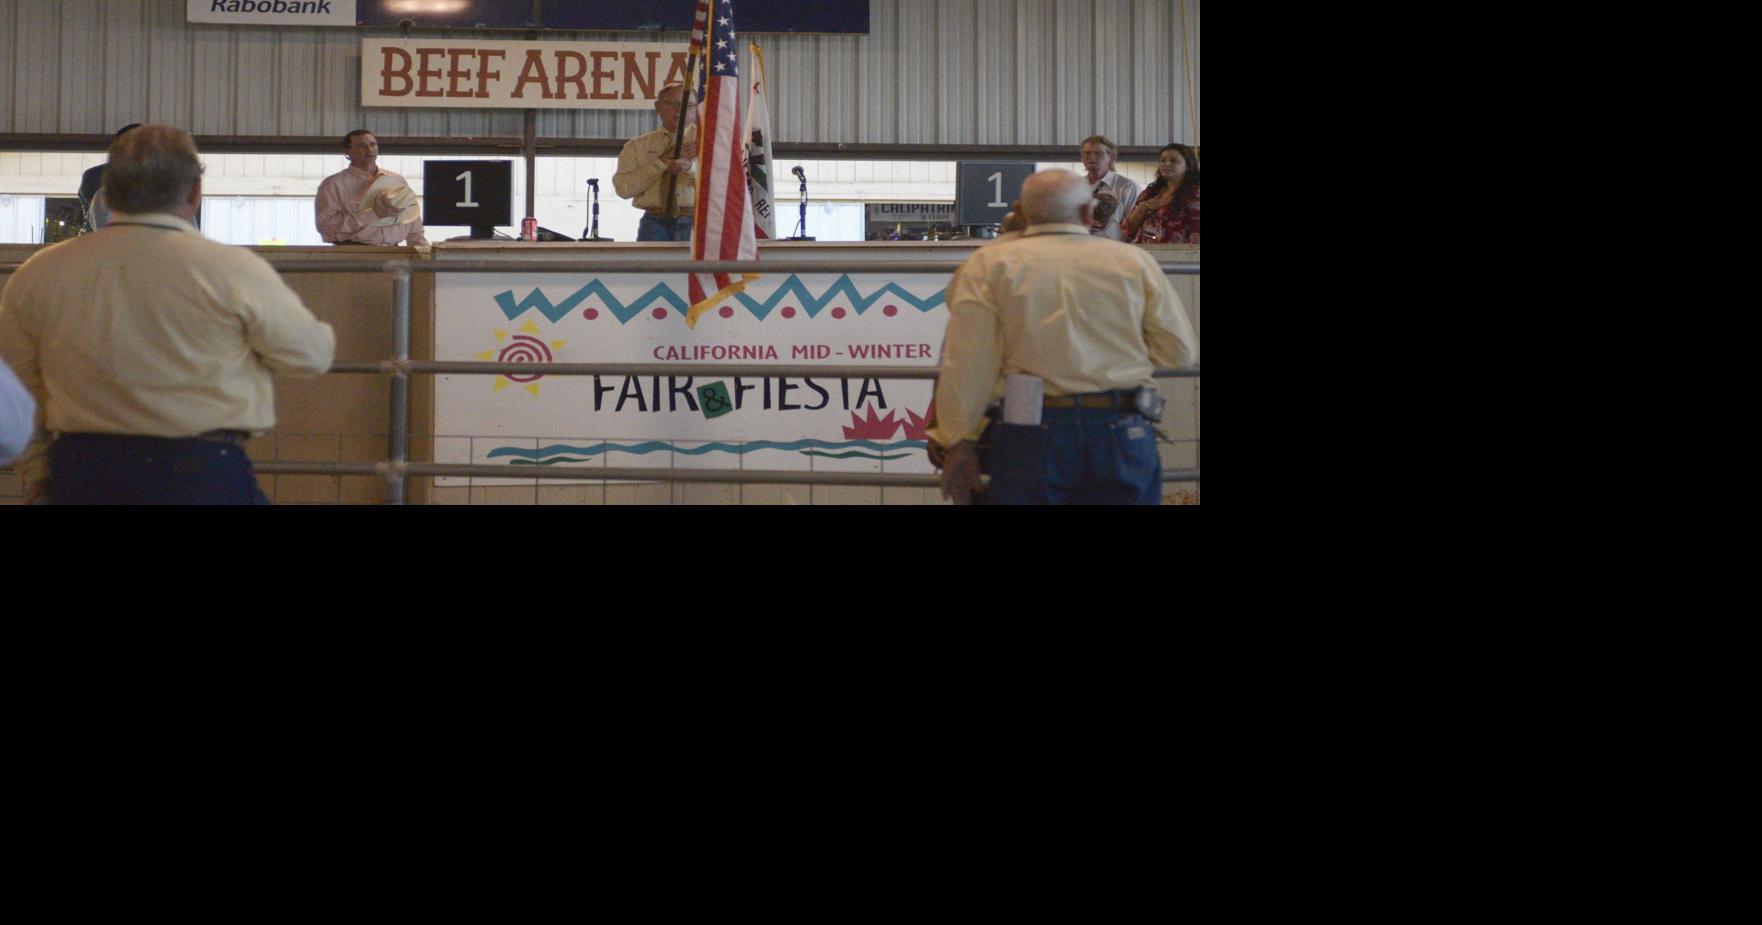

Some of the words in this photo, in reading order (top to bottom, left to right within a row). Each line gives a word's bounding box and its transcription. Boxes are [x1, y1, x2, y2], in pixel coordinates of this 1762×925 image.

[211, 0, 331, 14] Rabobank
[379, 47, 506, 98] BEEF
[456, 171, 479, 207] 1
[988, 172, 1008, 207] 1
[653, 345, 778, 360] CALIFORNIA
[593, 374, 699, 412] FAIR
